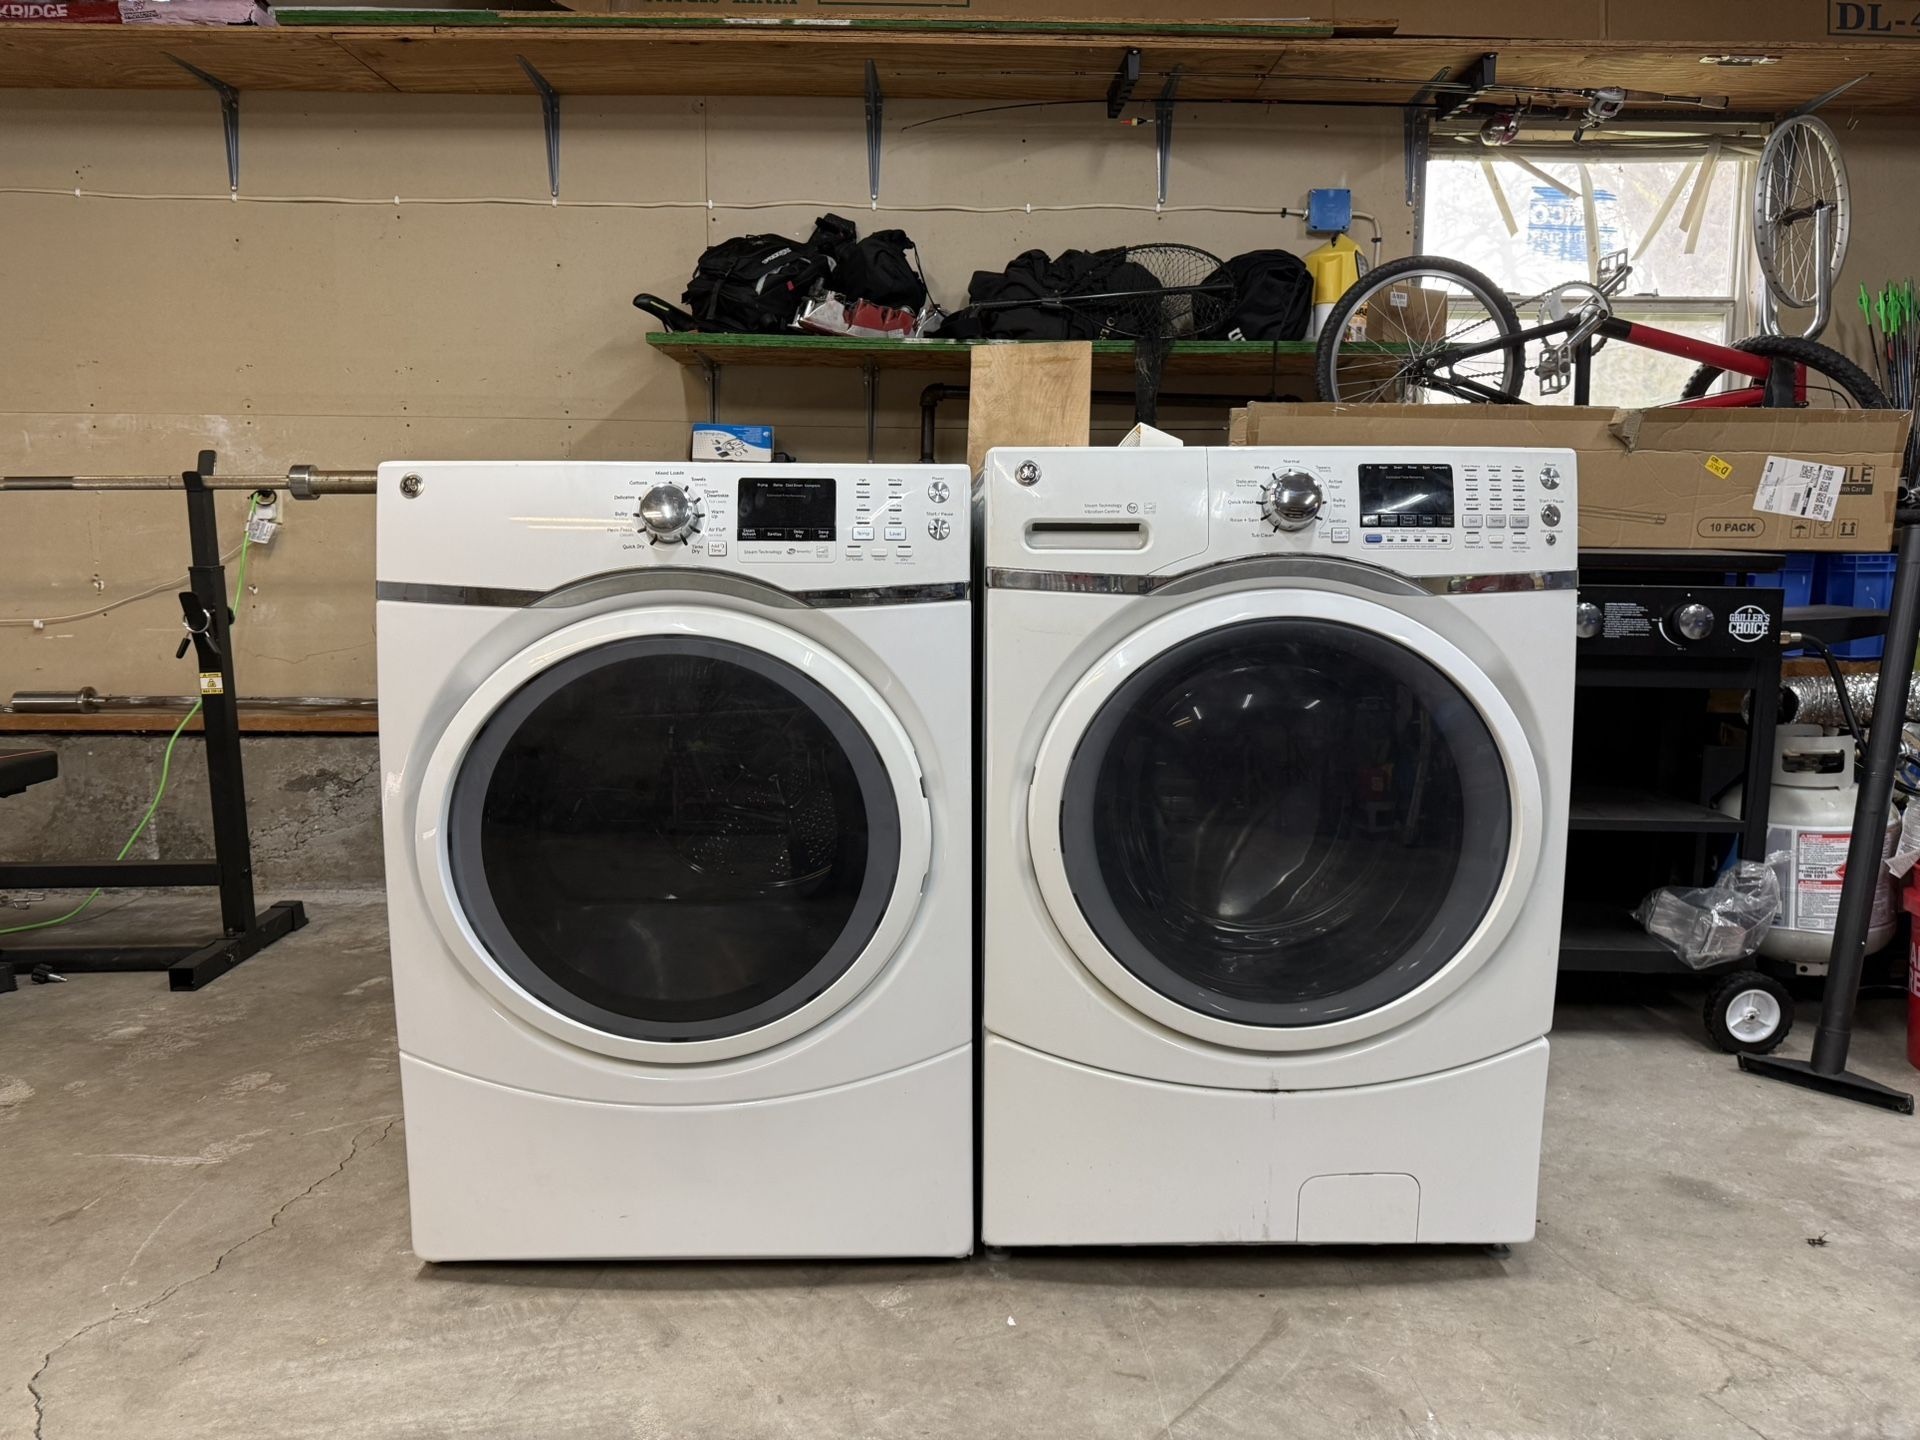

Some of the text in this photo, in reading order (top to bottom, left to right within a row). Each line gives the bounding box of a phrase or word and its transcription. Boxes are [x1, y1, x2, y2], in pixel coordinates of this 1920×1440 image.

[1710, 522, 1756, 532] 10 PACK
[1730, 614, 1770, 622] GRILLER'S
[1728, 622, 1769, 634] CHOICE
